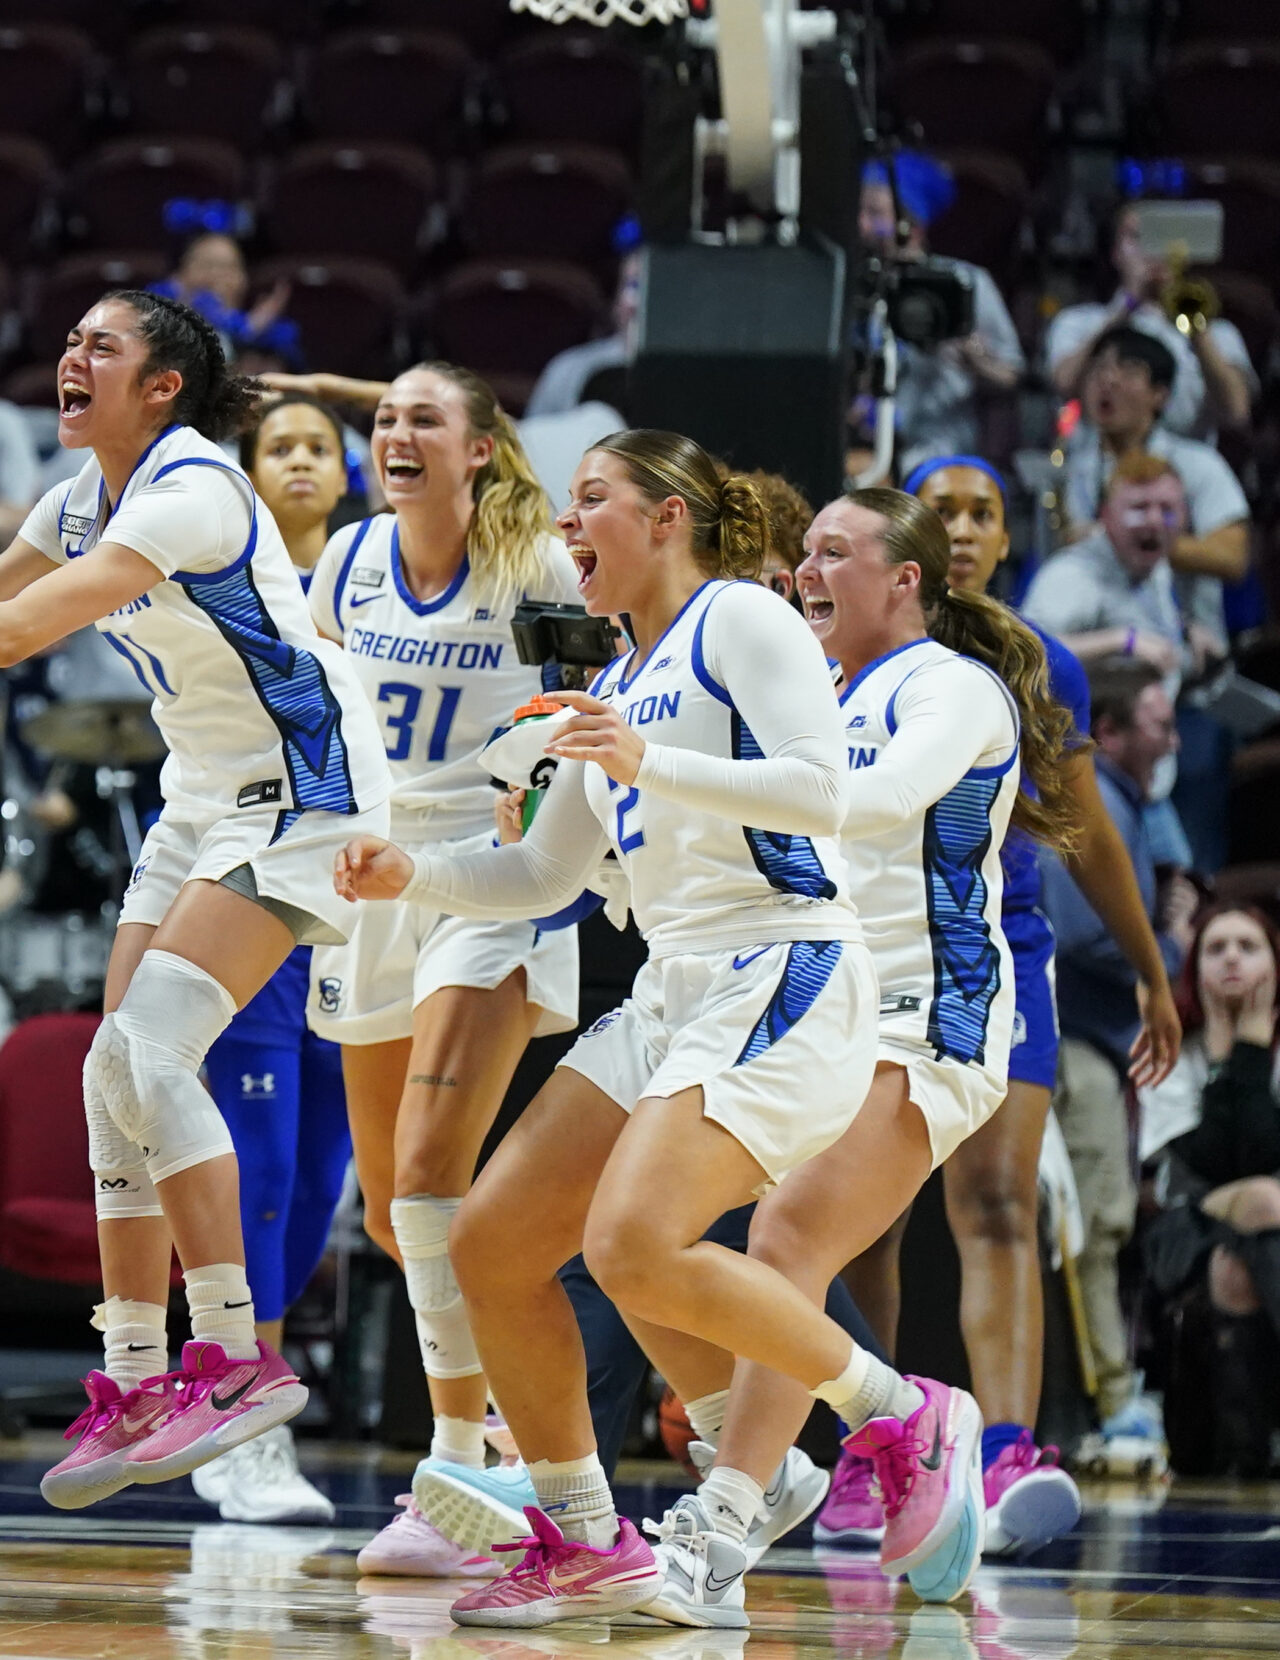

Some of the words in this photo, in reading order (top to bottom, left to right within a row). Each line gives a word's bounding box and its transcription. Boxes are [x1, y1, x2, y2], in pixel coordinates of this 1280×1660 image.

[101, 631, 179, 696] 11
[351, 629, 503, 669] CREIGHTON
[377, 682, 462, 761] 31
[265, 786, 275, 795] M
